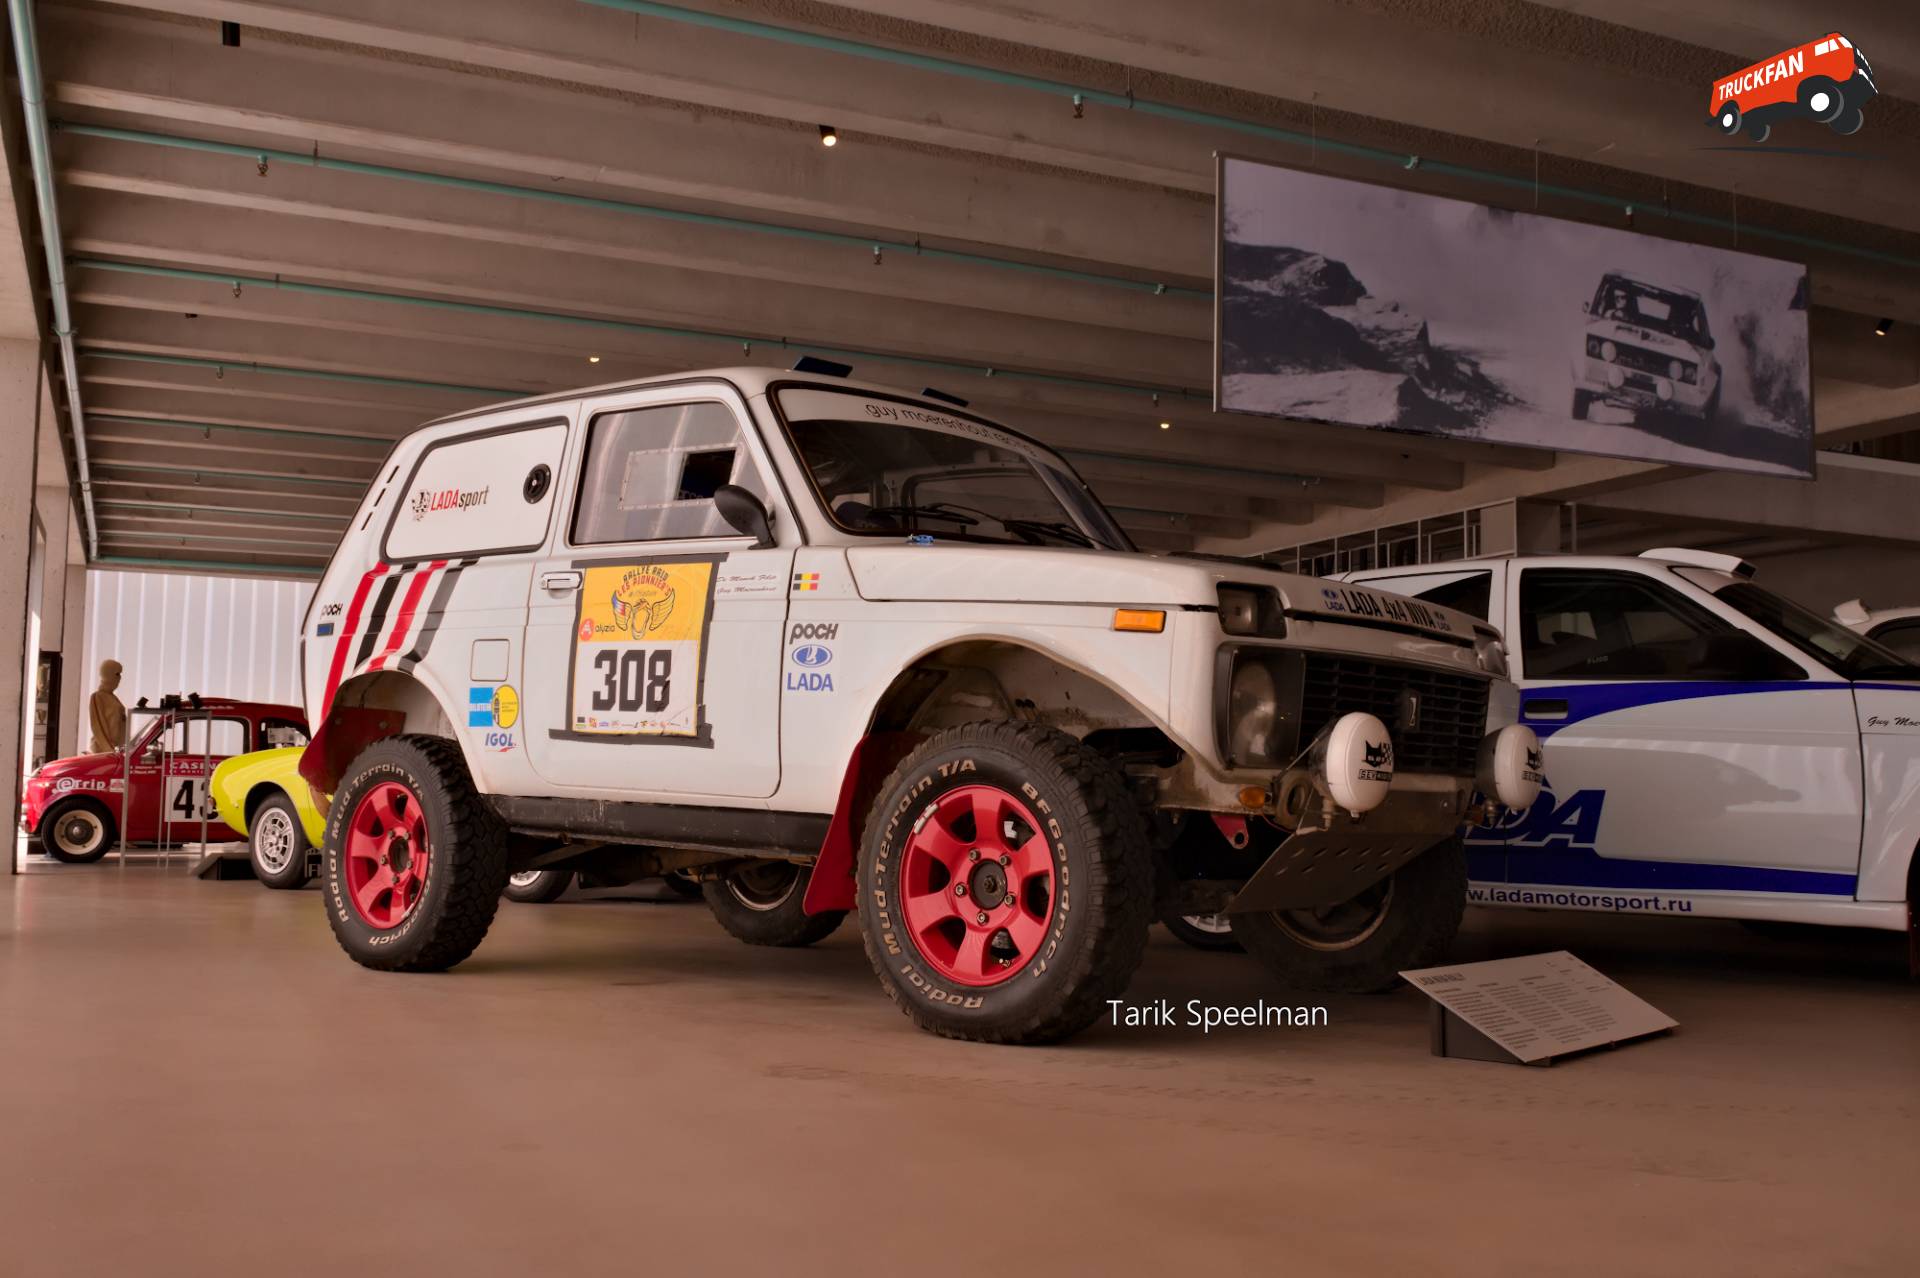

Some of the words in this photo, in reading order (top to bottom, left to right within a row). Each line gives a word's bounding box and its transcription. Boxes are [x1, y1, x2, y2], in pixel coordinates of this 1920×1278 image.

[865, 403, 899, 420] guy
[623, 565, 649, 583] RALLYE
[1325, 600, 1345, 612] LADA
[1340, 589, 1383, 617] LADA
[1381, 596, 1407, 621] 4x4
[1402, 600, 1437, 629] NIVA
[592, 649, 672, 713] 308
[786, 672, 834, 692] LADA
[1867, 716, 1889, 727] Guy
[485, 733, 513, 747] IGOL
[937, 758, 978, 778] T/A
[329, 849, 350, 922] Radial
[407, 773, 425, 801] T/A
[873, 775, 933, 956] Mud-Terrain
[1466, 887, 1692, 913] w.ladamotorsport.ru
[901, 964, 984, 1009] Radial
